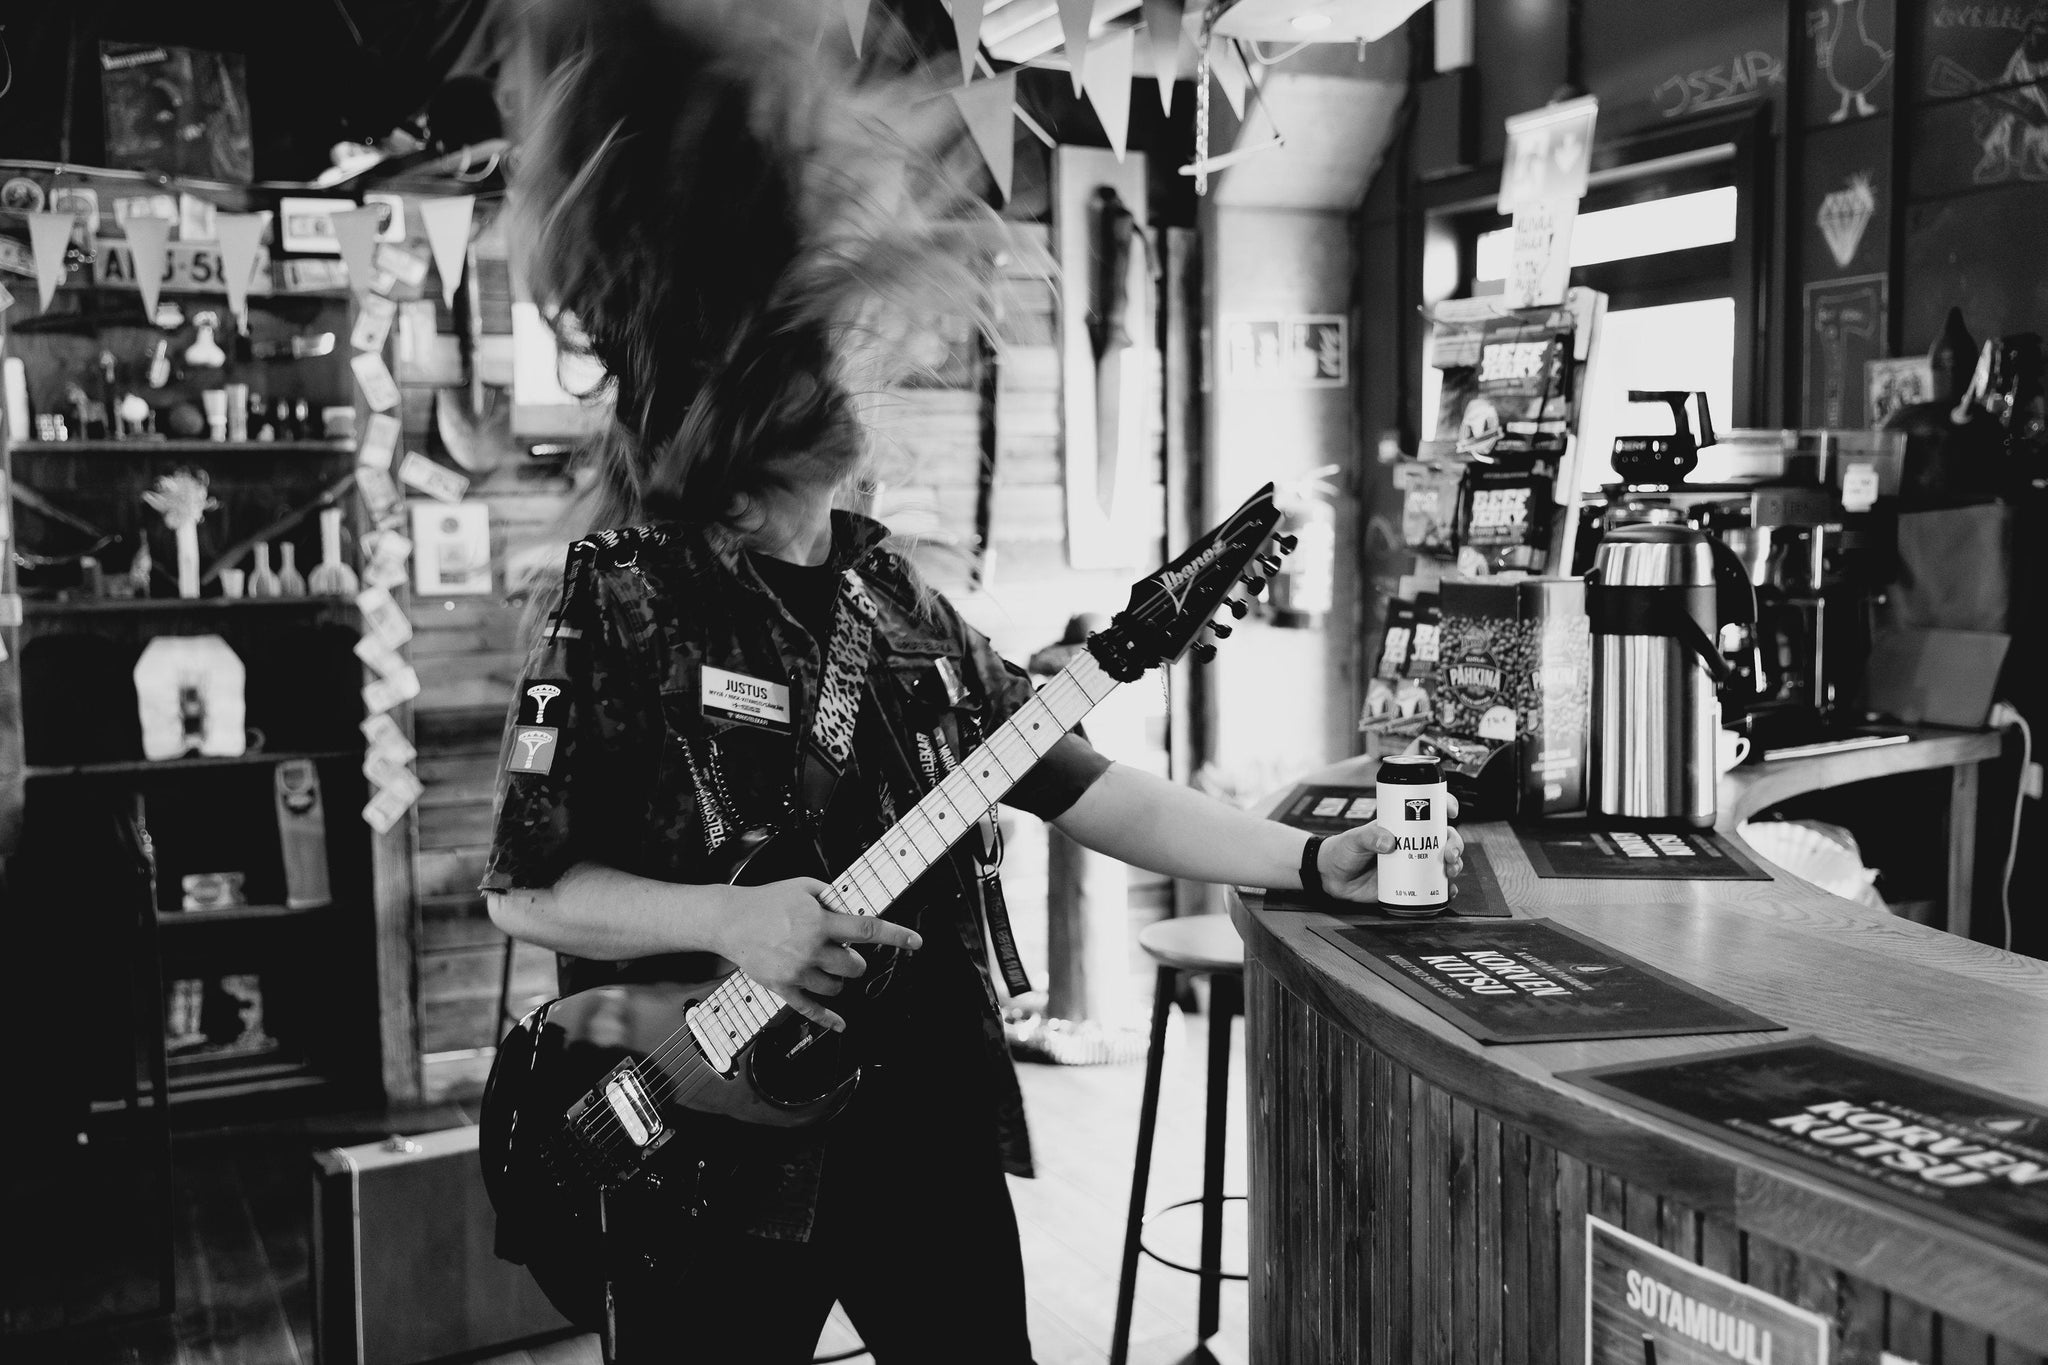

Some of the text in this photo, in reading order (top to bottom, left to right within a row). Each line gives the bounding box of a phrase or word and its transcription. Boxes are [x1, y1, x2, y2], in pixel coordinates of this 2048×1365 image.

[1159, 540, 1227, 592] Ibanez
[726, 679, 768, 700] JUSTUS
[1394, 835, 1439, 851] KALJAA
[1419, 955, 1517, 995] KUTSU
[1461, 950, 1573, 997] KORVEN
[1769, 1113, 1989, 1186] KUTSU
[1805, 1100, 2048, 1185] KORVEN
[1626, 1269, 1772, 1365] SOTAMUULI
